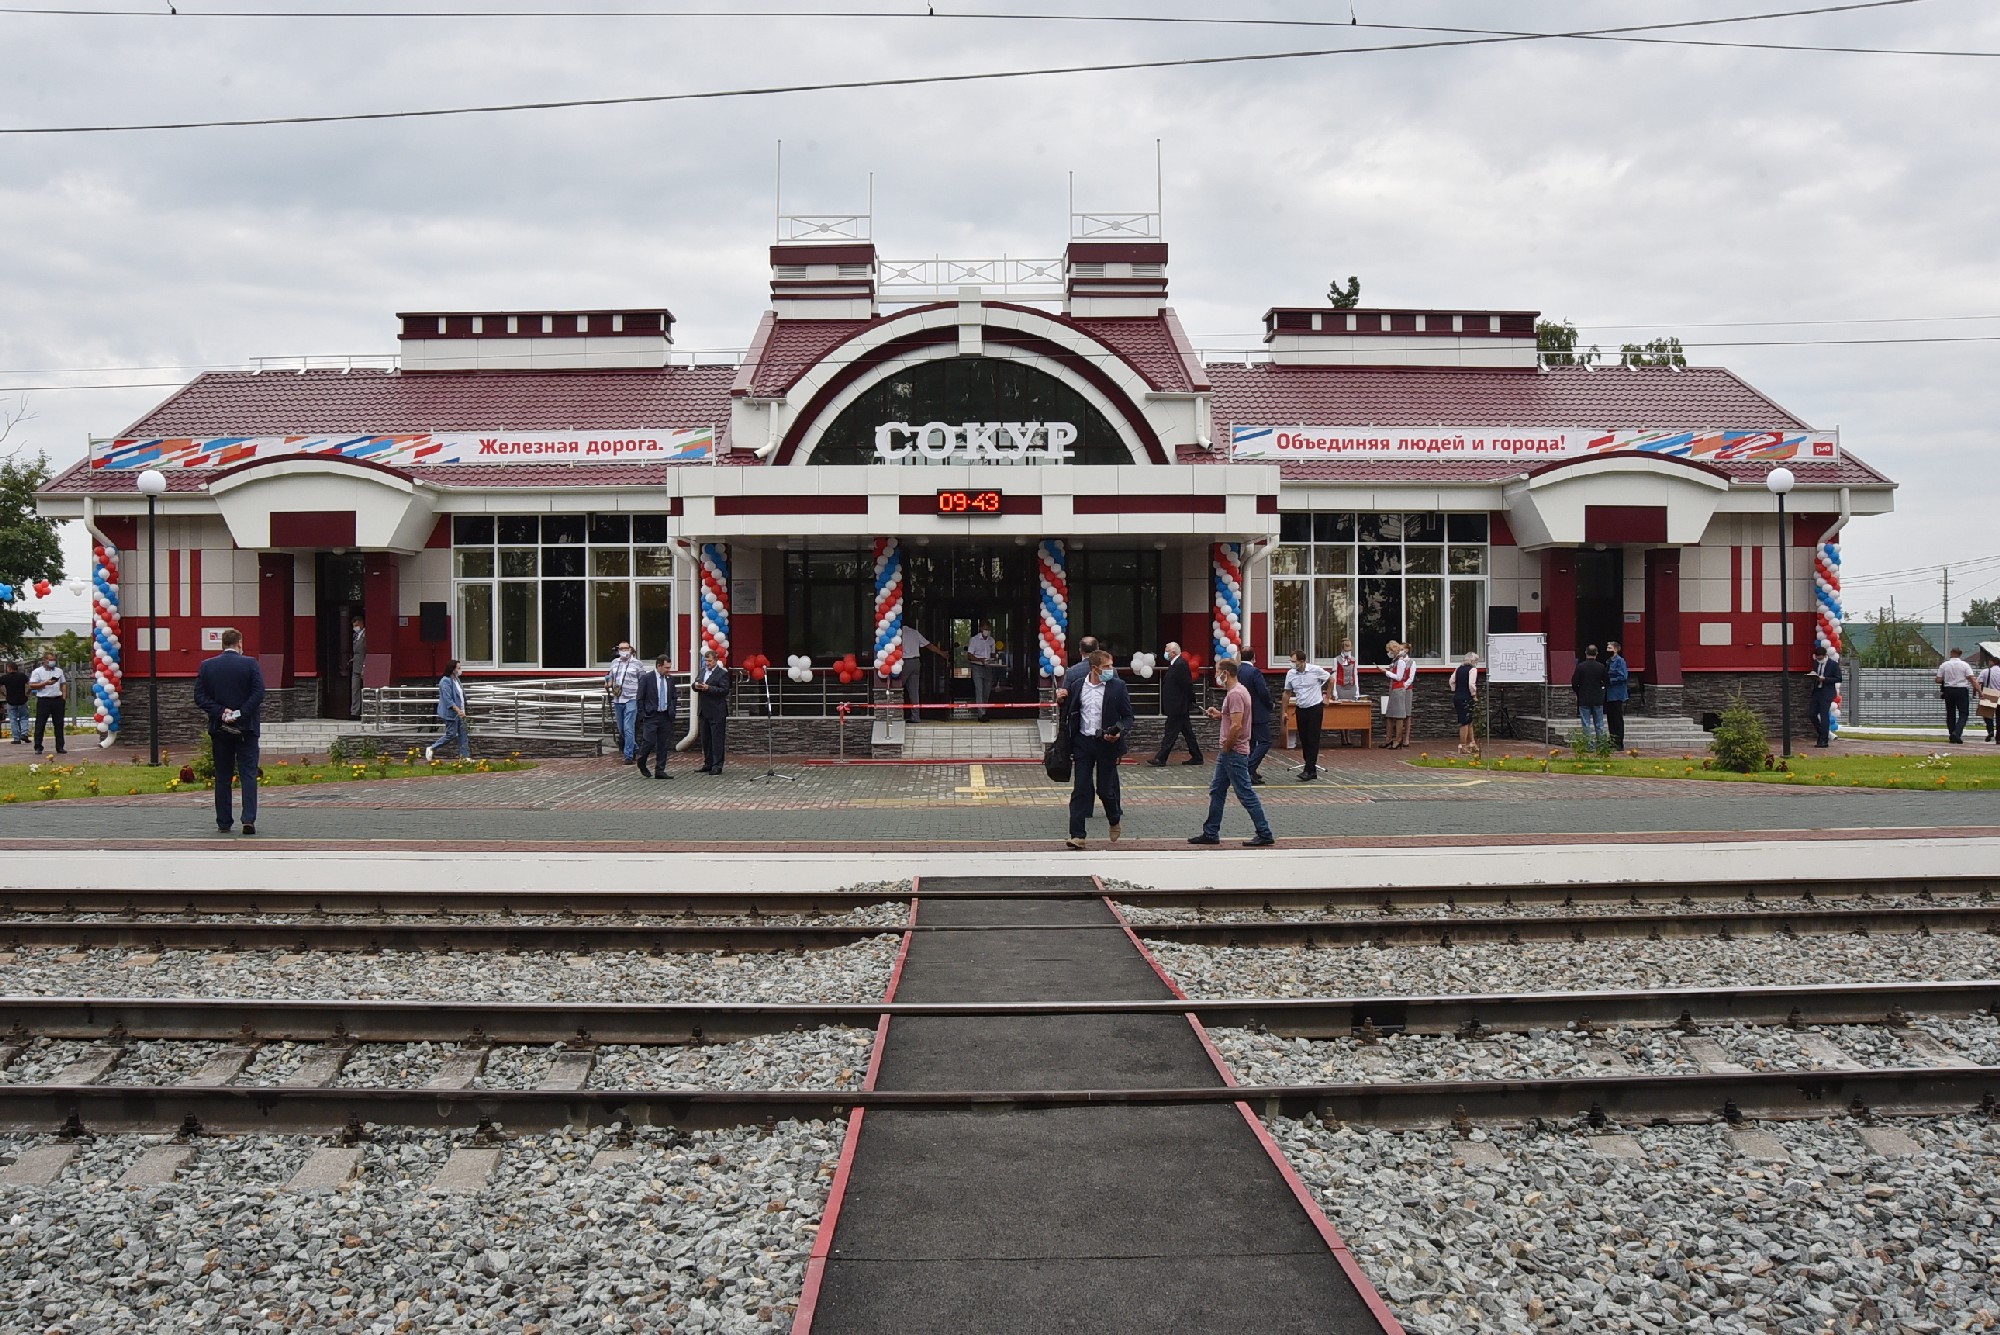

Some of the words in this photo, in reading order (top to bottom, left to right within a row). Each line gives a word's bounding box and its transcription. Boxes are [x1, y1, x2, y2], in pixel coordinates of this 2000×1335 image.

[479, 438, 579, 455] Железная
[586, 438, 664, 456] дорога.
[874, 421, 1078, 460] СОКУР
[1276, 432, 1390, 452] Объединяя
[1397, 434, 1465, 453] людей
[1472, 438, 1484, 450] и
[1492, 435, 1566, 454] города!
